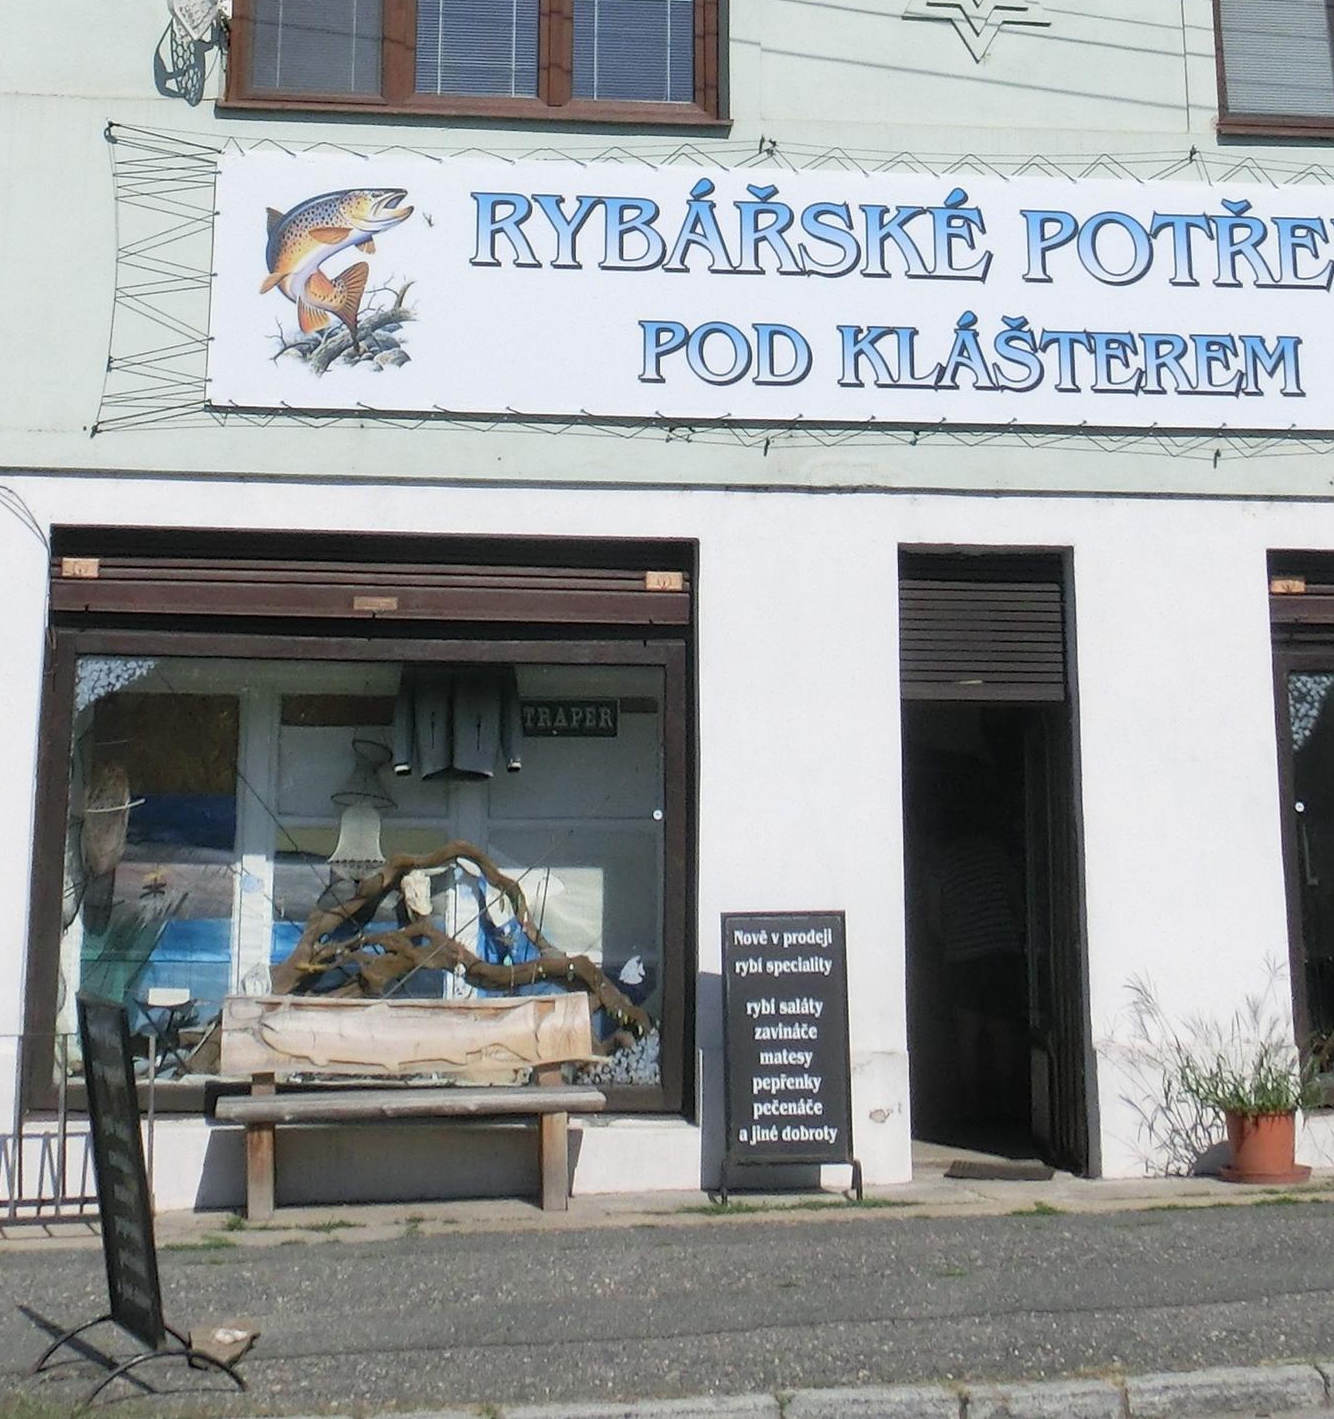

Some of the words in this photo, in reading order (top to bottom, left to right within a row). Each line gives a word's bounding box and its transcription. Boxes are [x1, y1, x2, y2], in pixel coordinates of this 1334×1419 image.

[470, 177, 991, 281] RYBÁŘSKÉ
[638, 319, 812, 387] POD
[838, 310, 1306, 397] KLÁŠTEREM
[523, 706, 614, 728] TRAPER
[771, 932, 779, 945] v
[782, 928, 832, 948] prodeji
[735, 958, 763, 977] rybí
[767, 958, 832, 977] speciality
[746, 998, 776, 1018] rybí
[779, 998, 824, 1018] saláty
[754, 1023, 818, 1040] zavináče
[760, 1050, 813, 1068] matesy
[752, 1074, 822, 1094] pepřenky
[753, 1099, 823, 1119] pečenáče
[739, 1129, 749, 1142] a
[749, 1125, 778, 1146] jiné
[782, 1125, 838, 1144] dobroty
